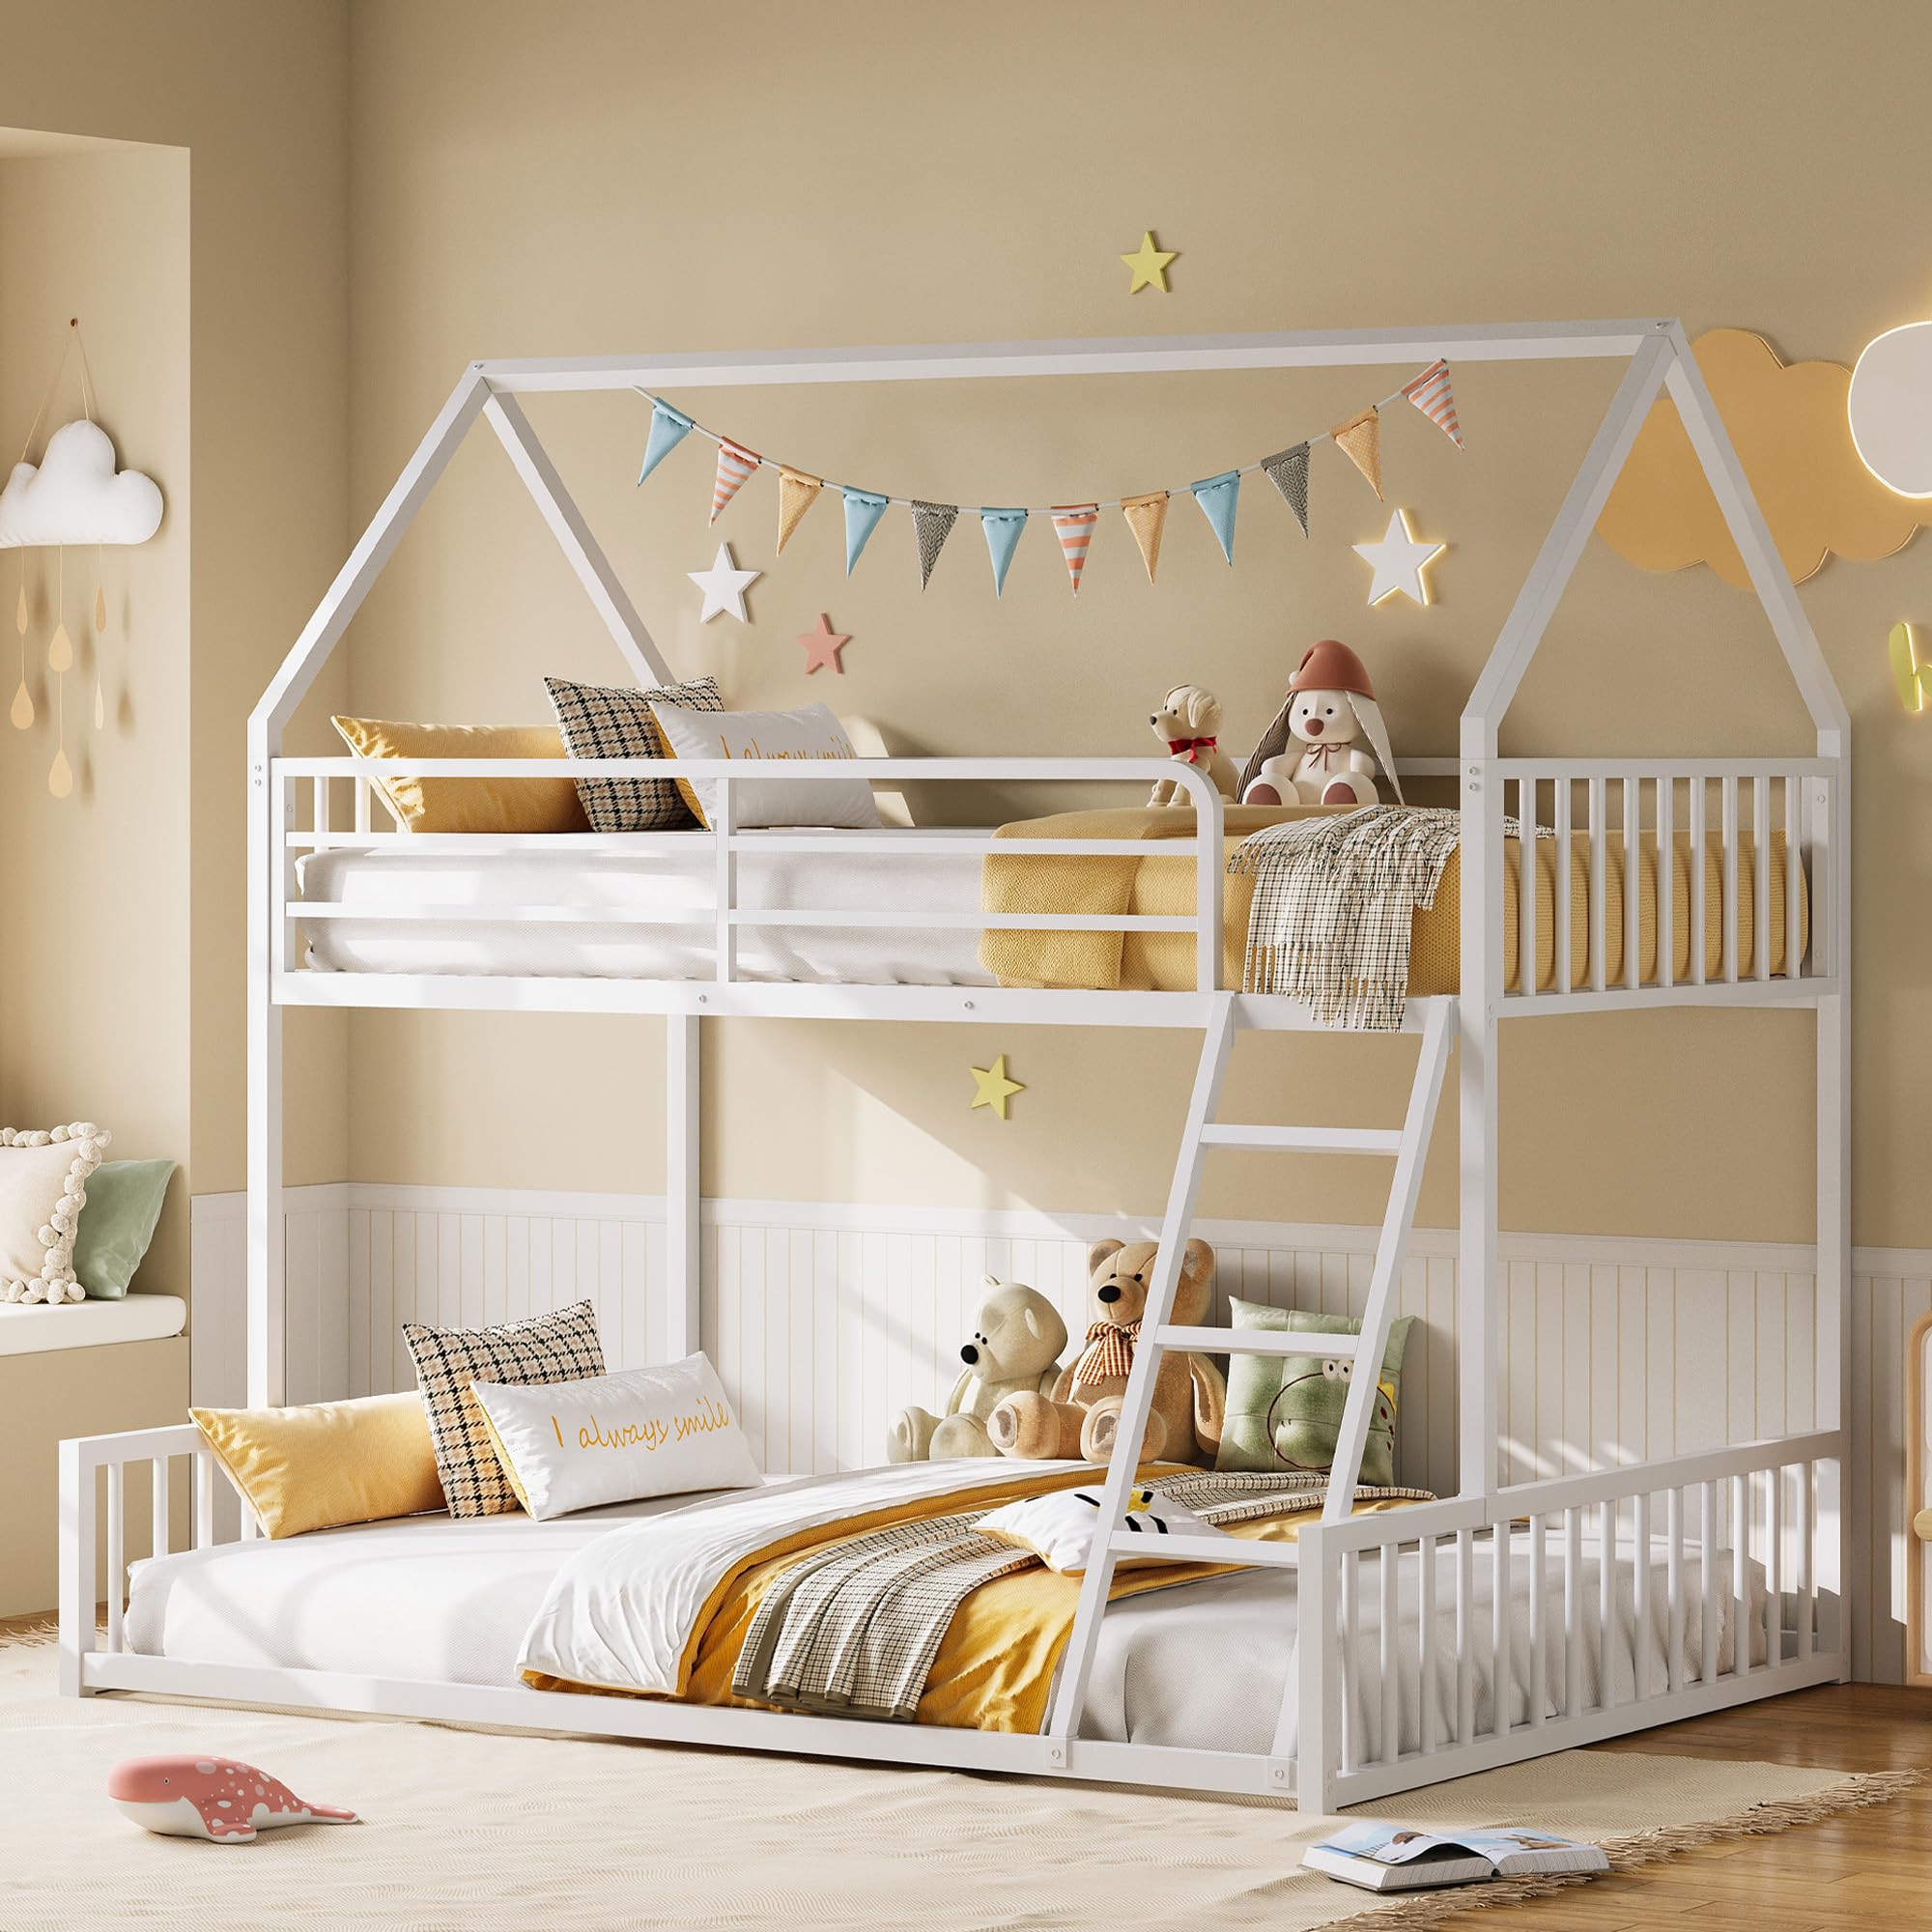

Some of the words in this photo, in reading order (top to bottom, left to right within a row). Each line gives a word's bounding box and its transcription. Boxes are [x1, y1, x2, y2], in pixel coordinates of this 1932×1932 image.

[552, 1415, 564, 1448] I
[579, 1415, 668, 1451] always
[674, 1396, 729, 1441] smile
